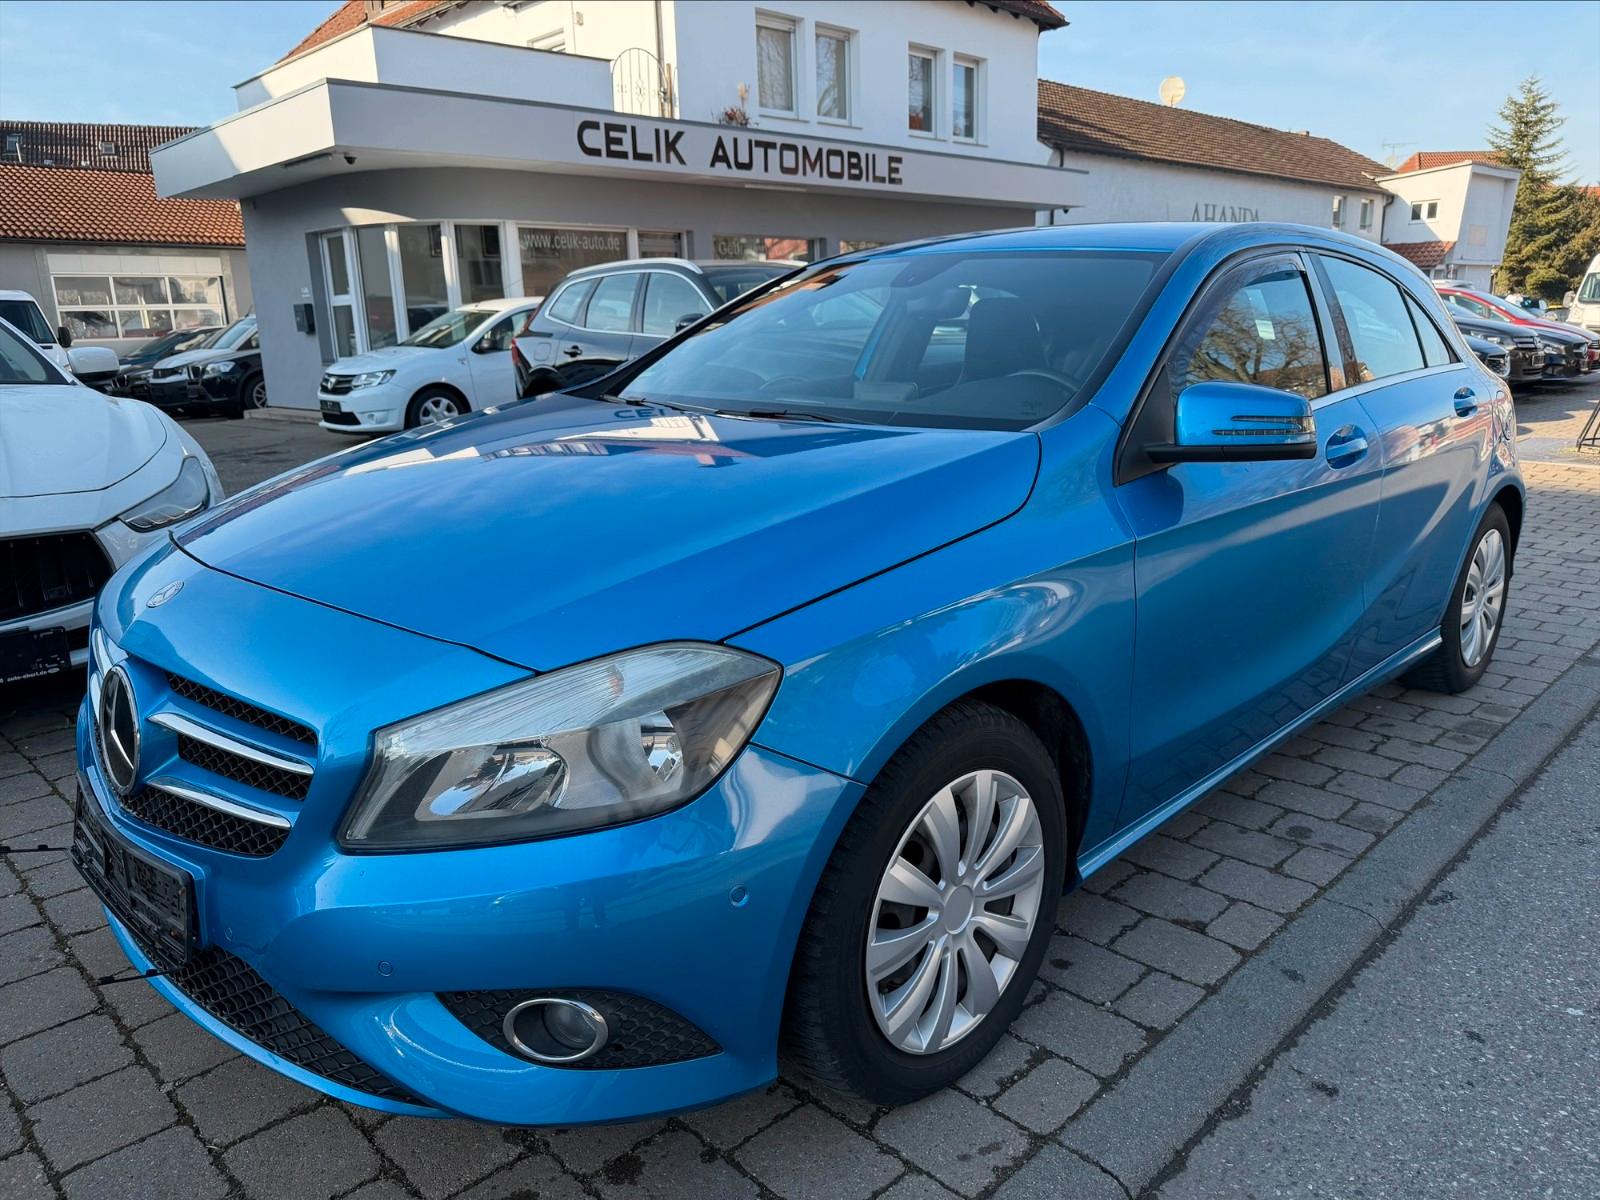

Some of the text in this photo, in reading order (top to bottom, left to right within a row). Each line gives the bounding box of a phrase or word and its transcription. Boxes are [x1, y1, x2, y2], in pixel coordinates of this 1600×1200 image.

[577, 120, 903, 185] CELIK AUTOMOBILE
[523, 232, 620, 250] www.celik-auto.de
